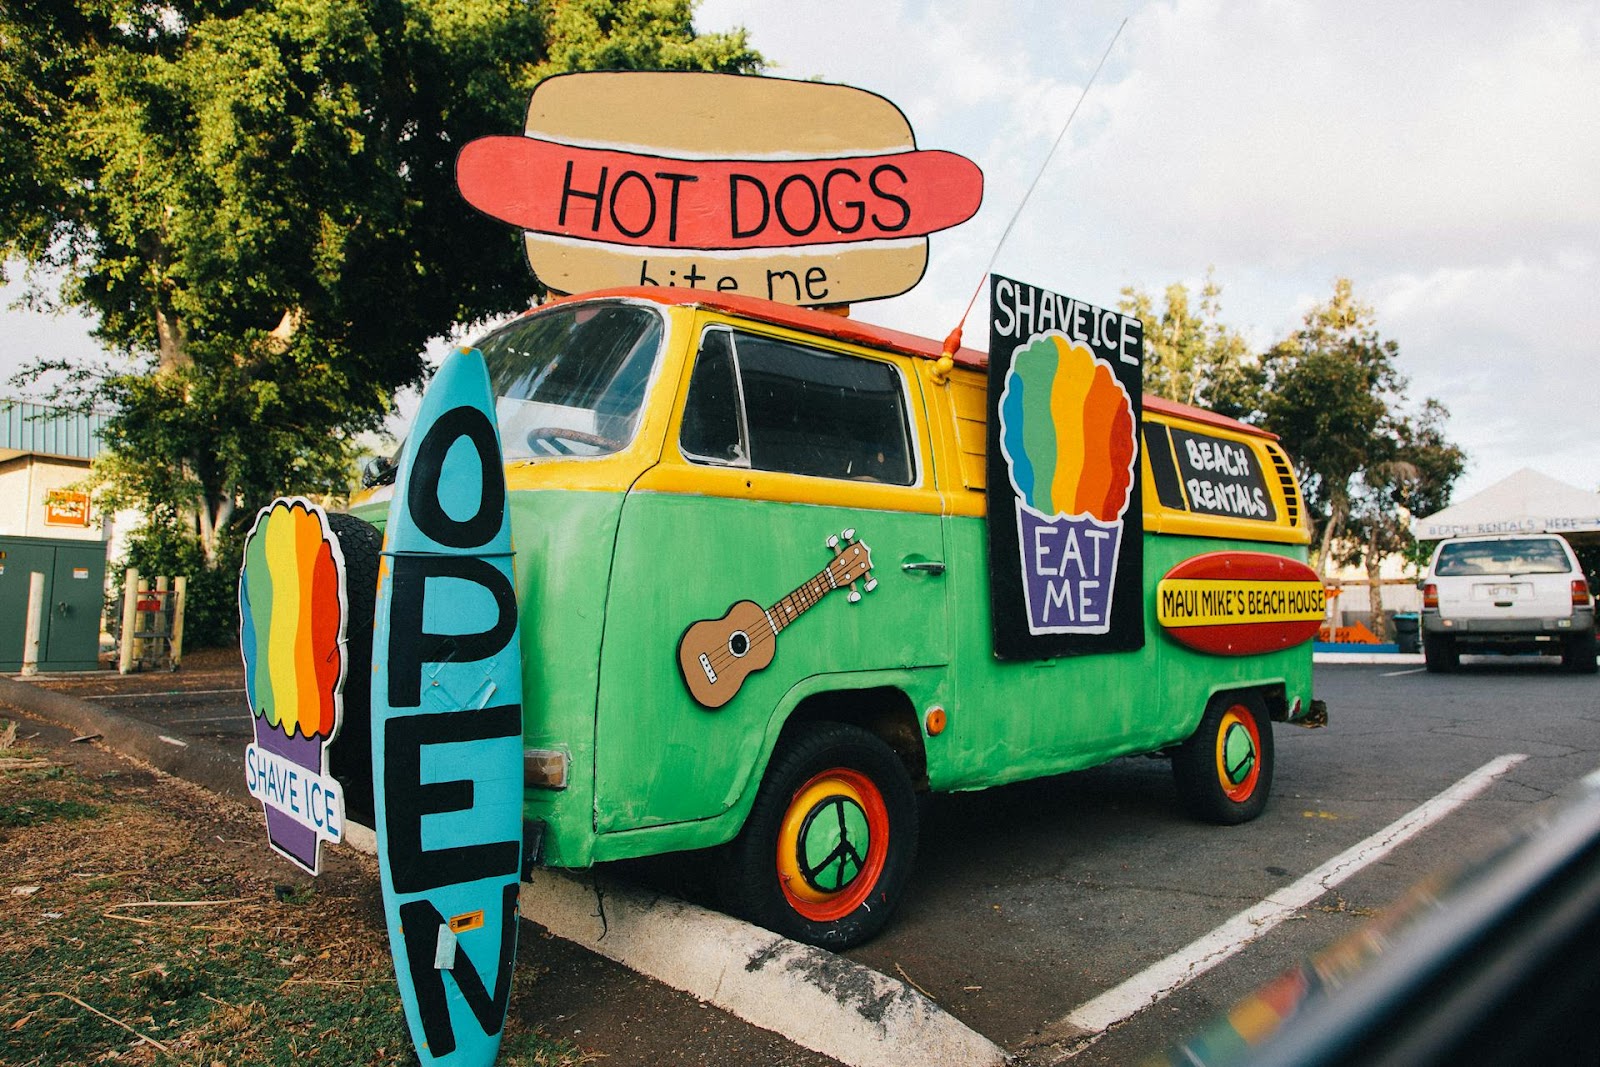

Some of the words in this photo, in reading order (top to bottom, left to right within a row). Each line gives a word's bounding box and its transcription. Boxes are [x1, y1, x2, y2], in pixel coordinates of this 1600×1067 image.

[558, 160, 699, 242] HOT
[729, 164, 911, 239] DOGS
[766, 267, 829, 301] me
[1185, 438, 1250, 476] BEACH
[1187, 478, 1267, 517] RENTALS
[1429, 525, 1469, 536] BEACH
[1478, 519, 1536, 534] RENTALS
[1545, 517, 1578, 530] HERE
[1035, 527, 1109, 578] EAT
[1042, 579, 1100, 623] ME
[1163, 590, 1199, 618] MAUI
[1202, 590, 1245, 617] MIKE'S
[1249, 590, 1286, 615] BEACH
[1289, 590, 1325, 614] HOUSE
[385, 405, 522, 1059] OPEN
[248, 748, 300, 814] SHAVE
[305, 778, 339, 837] ICE
